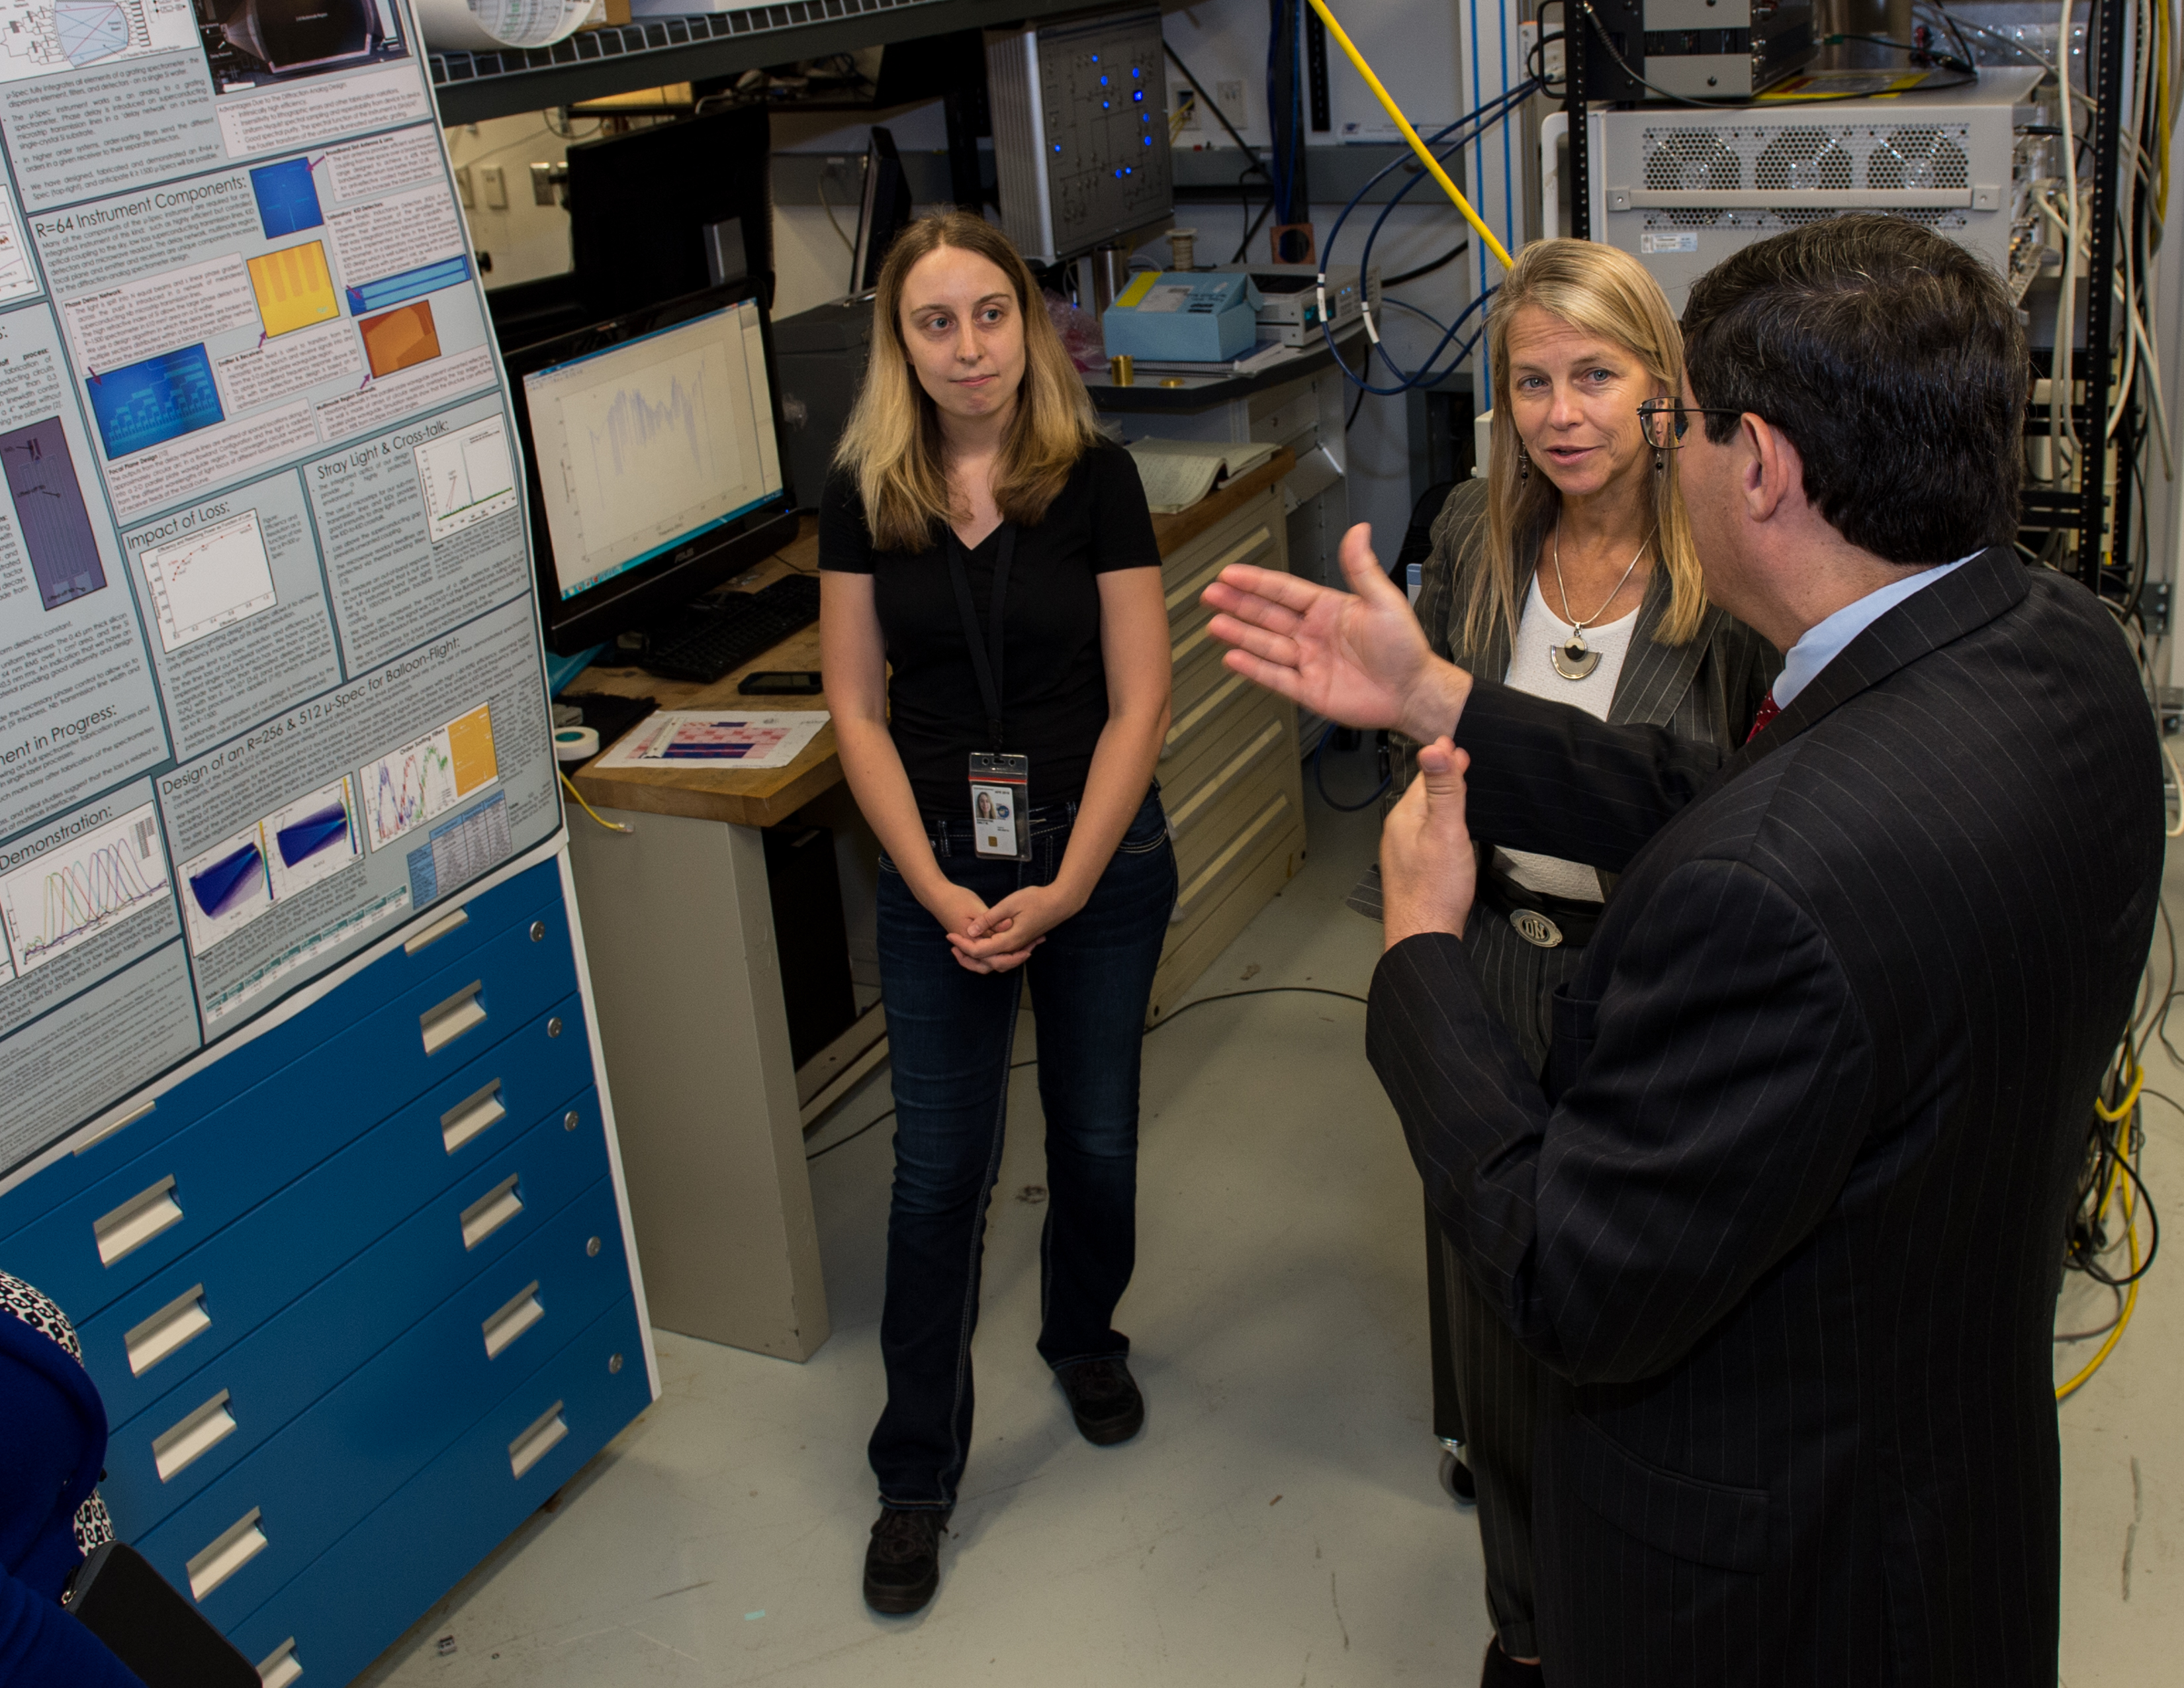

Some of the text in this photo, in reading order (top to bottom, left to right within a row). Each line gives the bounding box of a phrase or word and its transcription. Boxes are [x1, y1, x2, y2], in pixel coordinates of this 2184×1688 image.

[34, 177, 246, 238] R=64 Instrument Components:
[99, 288, 122, 299] Network:
[318, 459, 349, 479] Stray
[349, 445, 379, 467] Light
[381, 439, 390, 455] &
[392, 420, 449, 449] Cross-talk:
[126, 502, 230, 549] Impact of Loss:
[33, 734, 48, 749] in
[50, 704, 116, 742] Progress:
[161, 763, 208, 795] Design
[210, 752, 224, 771] of
[227, 745, 245, 762] an
[246, 722, 283, 752] R=256
[285, 716, 296, 732] &
[299, 704, 321, 726] 512
[367, 676, 383, 691] for
[385, 637, 459, 682] Balloon-Flight:
[0, 805, 112, 870] Demonstration:
